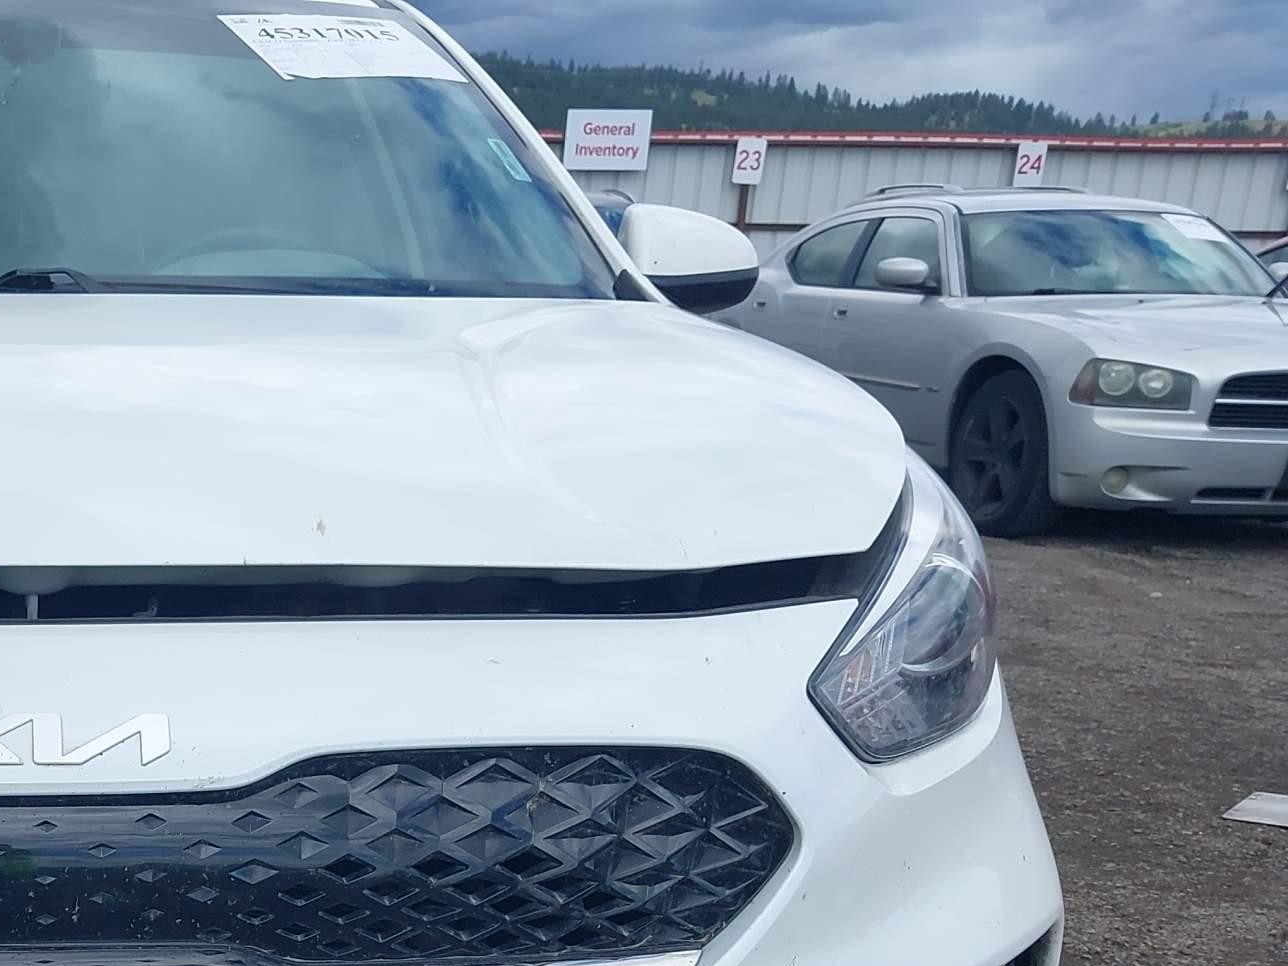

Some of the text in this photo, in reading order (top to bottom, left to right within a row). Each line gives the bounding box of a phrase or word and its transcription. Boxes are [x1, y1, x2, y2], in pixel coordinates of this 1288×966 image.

[258, 27, 400, 42] 45317015
[583, 122, 635, 136] General
[575, 143, 639, 160] Inventory
[736, 150, 762, 171] 23
[1017, 154, 1043, 175] 24
